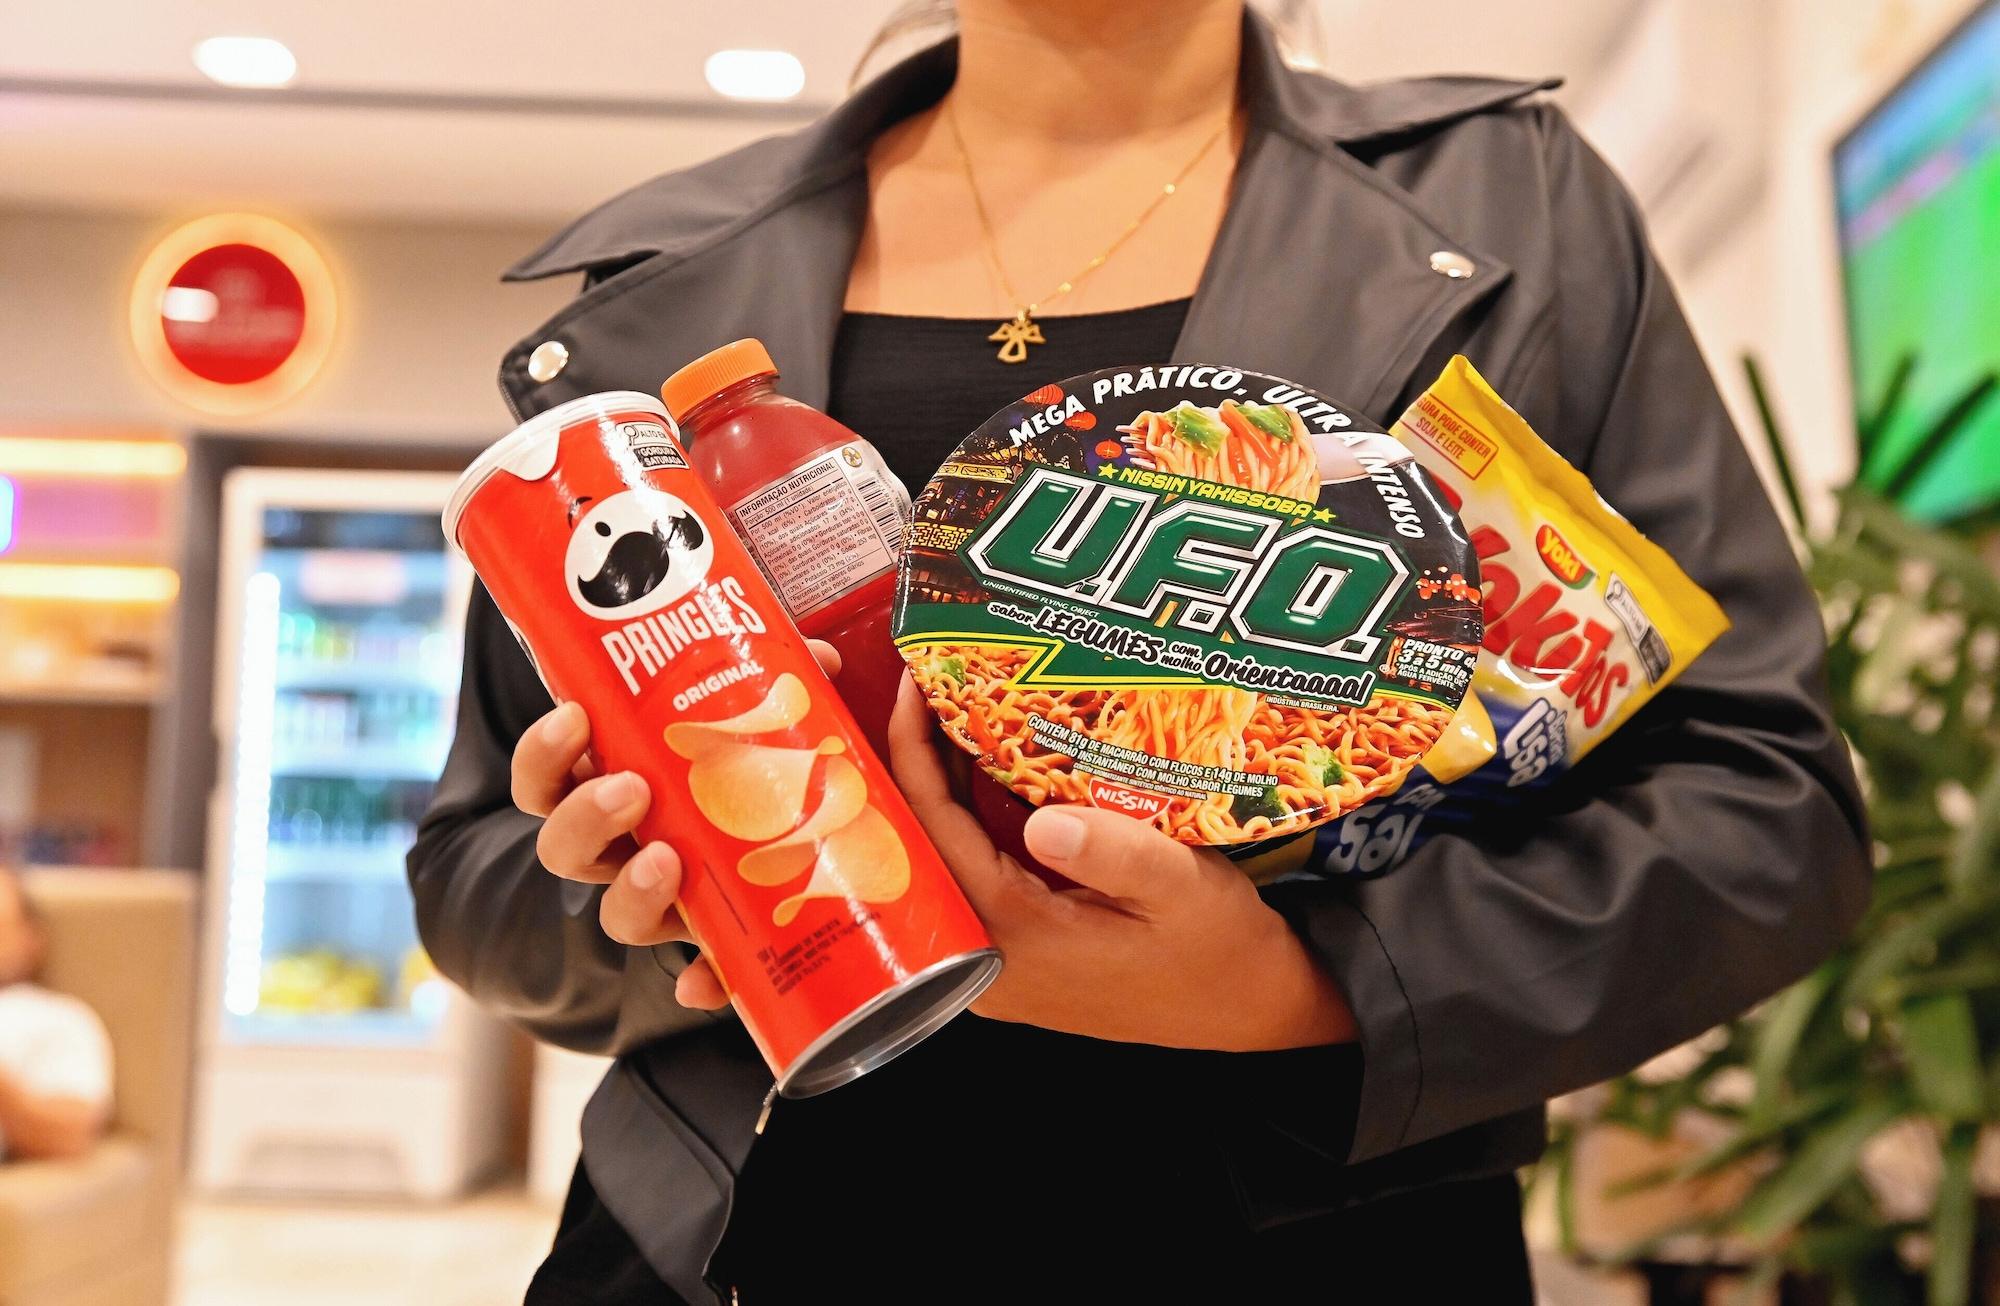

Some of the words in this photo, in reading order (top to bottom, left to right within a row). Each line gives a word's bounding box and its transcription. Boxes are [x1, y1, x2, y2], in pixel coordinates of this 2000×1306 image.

[1416, 397, 1440, 420] GORA
[1437, 413, 1462, 435] PODE
[1458, 429, 1492, 459] CONTER
[1416, 416, 1439, 438] SOJA
[1436, 432, 1446, 443] E
[1441, 437, 1466, 460] LEITE
[641, 447, 676, 457] GORDURA
[644, 456, 684, 467] SATURADA
[1009, 395, 1086, 447] MEGA
[1263, 384, 1369, 447] ULTRA
[1354, 451, 1426, 539] INTENSO
[739, 483, 789, 518] INFORMAÇÃO
[789, 462, 836, 490] NUTRICIONAL
[1119, 467, 1188, 492] NISSIN
[1187, 478, 1313, 517] YAKISSOBA
[760, 519, 772, 529] 500
[777, 531, 787, 540] dos
[817, 520, 842, 537] Gorduras
[787, 555, 797, 564] das
[810, 532, 836, 550] Gorduras
[966, 467, 1411, 664] U.F.O.
[982, 579, 1040, 601] UNIDENTIFIED
[1039, 596, 1069, 611] FLYING
[1070, 605, 1100, 618] OBJECT
[600, 575, 767, 697] PRINGLES
[989, 602, 1034, 625] sabor
[1034, 608, 1164, 663] LEGUMES
[1160, 653, 1203, 673] molho
[1171, 642, 1201, 658] com
[1398, 648, 1415, 663] 3
[1413, 657, 1424, 667] a
[1424, 654, 1443, 670] 5
[1402, 638, 1465, 661] PRONTO
[672, 660, 765, 712] ORIGINAL
[1397, 669, 1418, 680] ÁGUA
[1418, 674, 1457, 691] FERVENTE.
[1426, 669, 1454, 682] ADIÇÃO
[1266, 695, 1300, 708] INDÚSTRIA
[1300, 701, 1340, 713] BRASILEIRA.
[1027, 714, 1069, 740] CONTÉM
[1069, 729, 1089, 750] 81g
[1088, 738, 1100, 752] DE
[1100, 742, 1149, 765] MACARRÃO
[1149, 756, 1169, 770] COM
[1170, 761, 1204, 778] FLOCOS
[1205, 768, 1211, 778] E
[1213, 767, 1233, 784] 14g
[1233, 773, 1246, 784] DE
[1247, 774, 1278, 787] MOLHO
[1032, 732, 1078, 758] MACARRÃO
[1078, 749, 1135, 776] INSTANTÂNEO
[1136, 767, 1157, 780] COM
[1157, 771, 1190, 787] MOLHO
[1190, 777, 1221, 793] SABOR
[1221, 783, 1264, 798] LEGUMES
[1095, 786, 1160, 813] NISSIN
